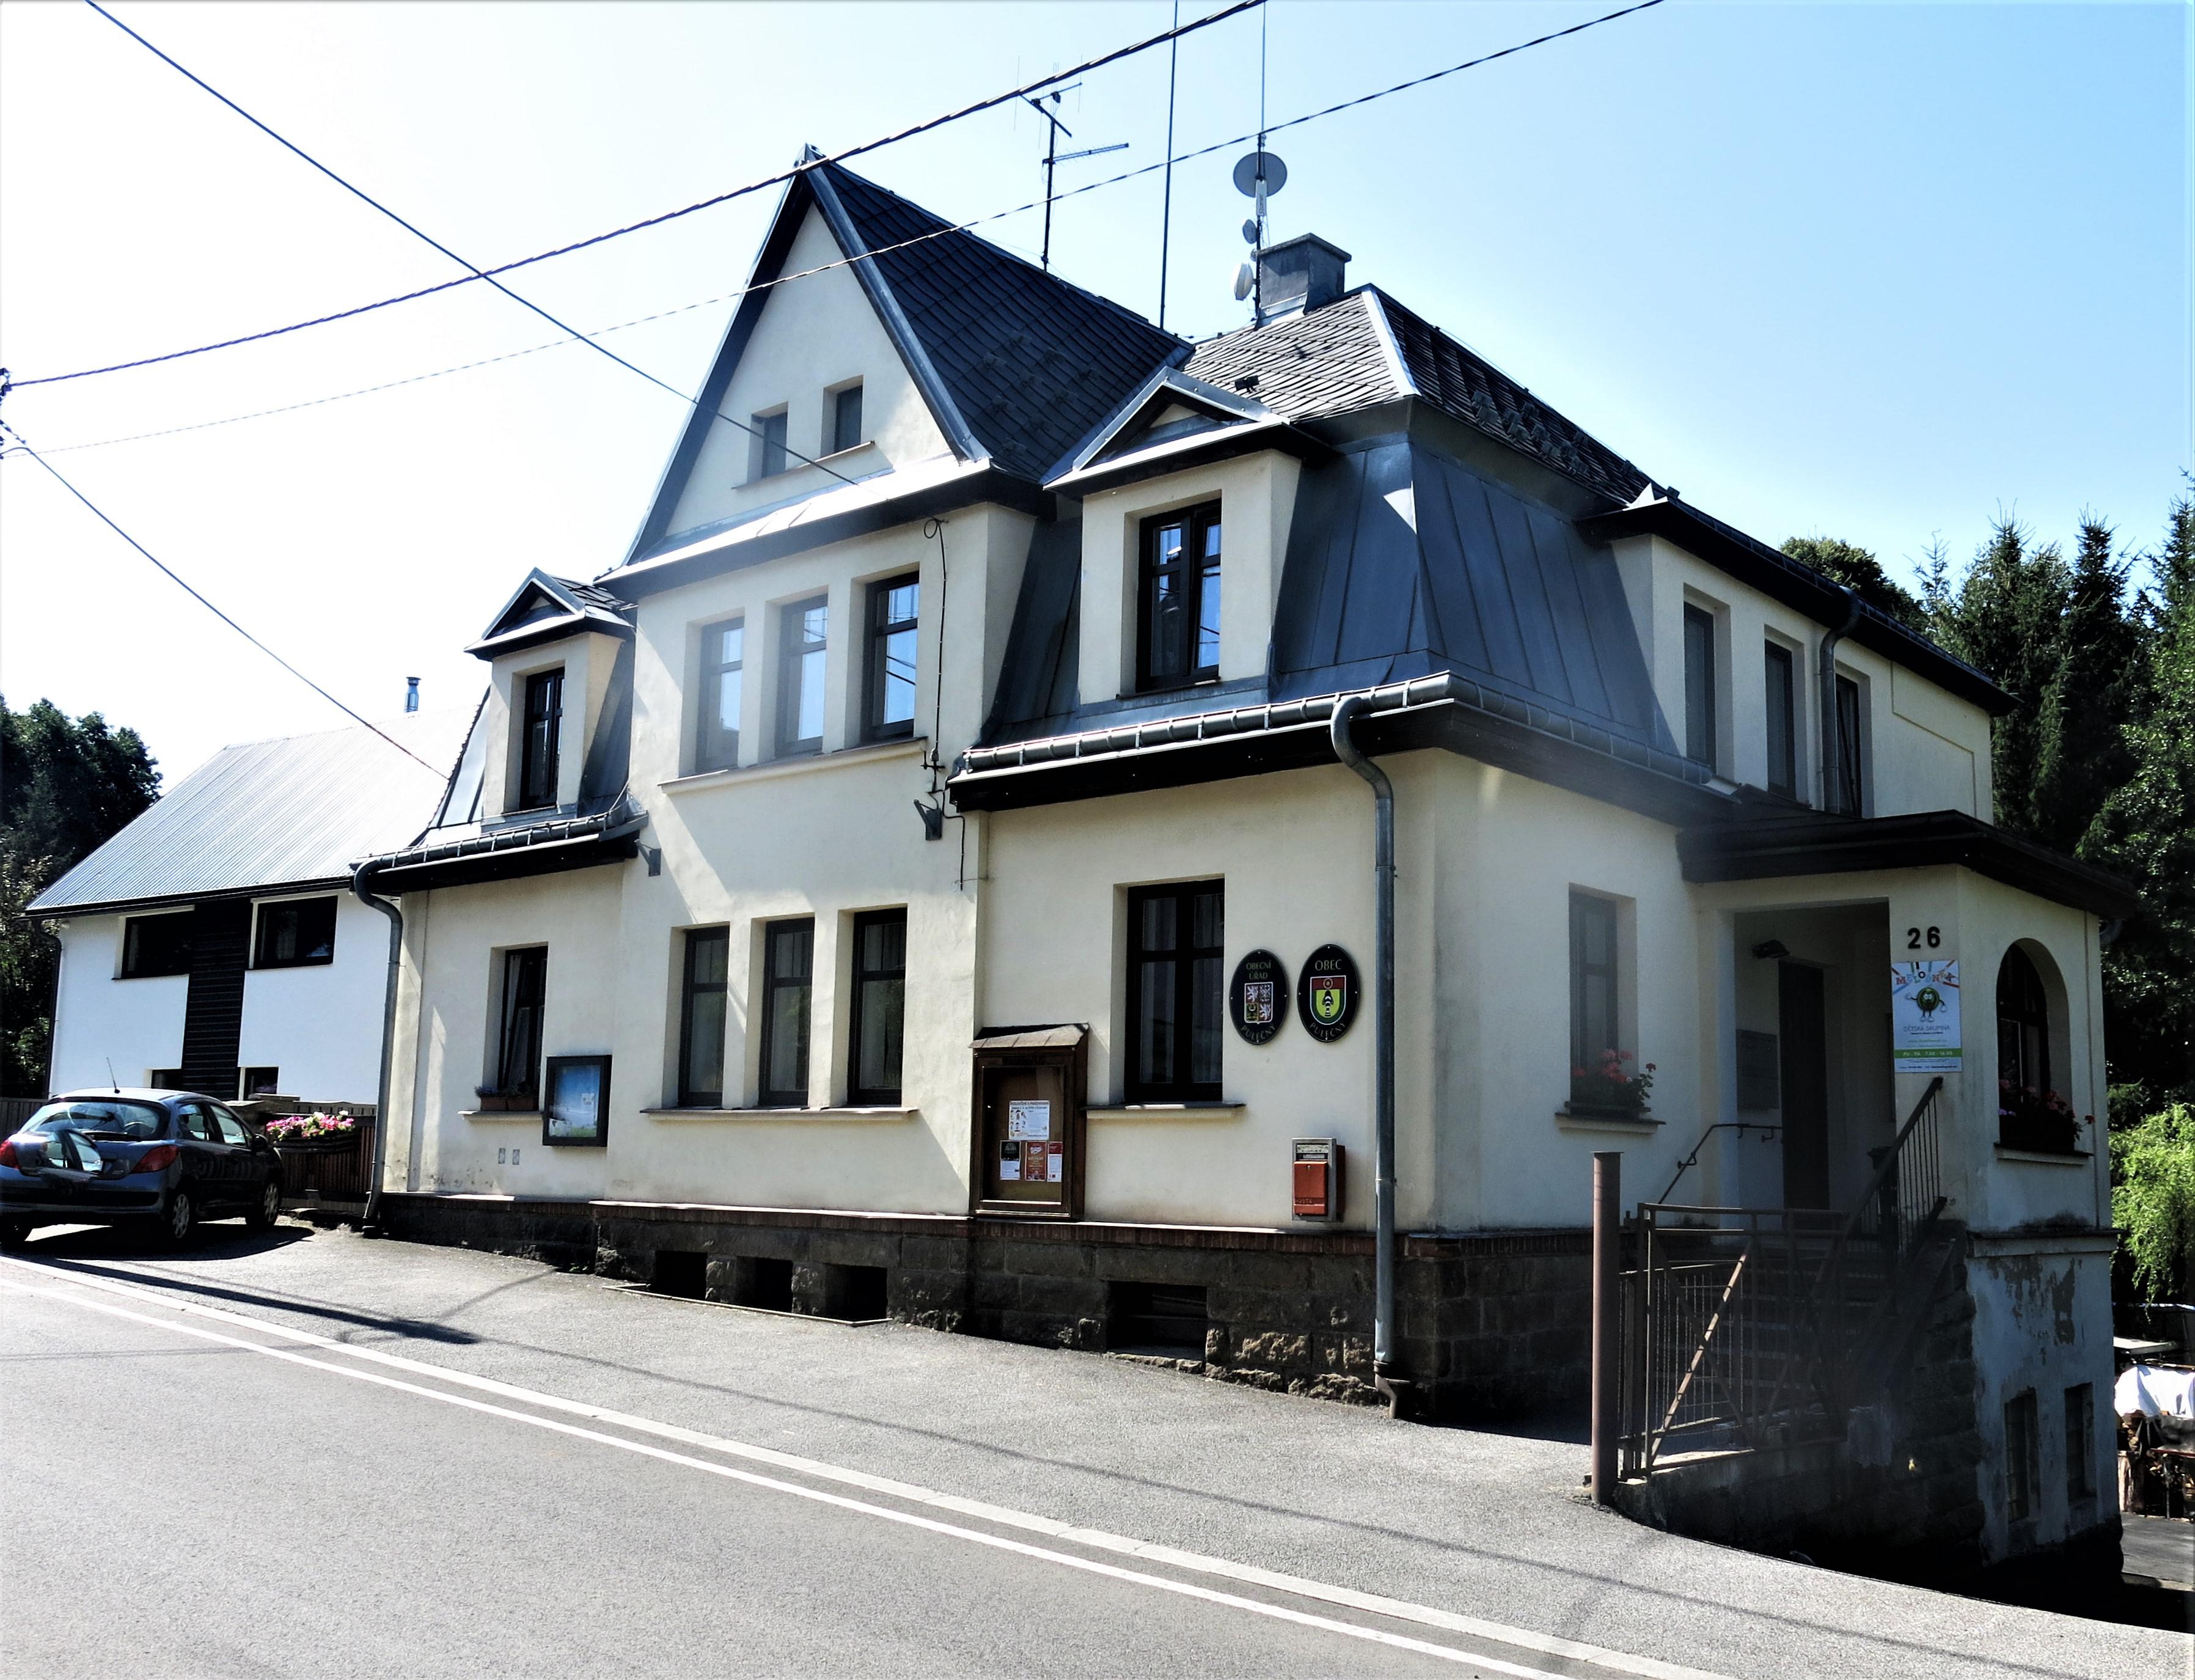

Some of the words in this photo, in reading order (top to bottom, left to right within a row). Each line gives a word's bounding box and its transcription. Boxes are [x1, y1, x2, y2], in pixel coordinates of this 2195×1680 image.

[1907, 926, 1941, 949] 26
[1245, 959, 1272, 970] OBECNÍ
[1314, 959, 1343, 971] OBEC
